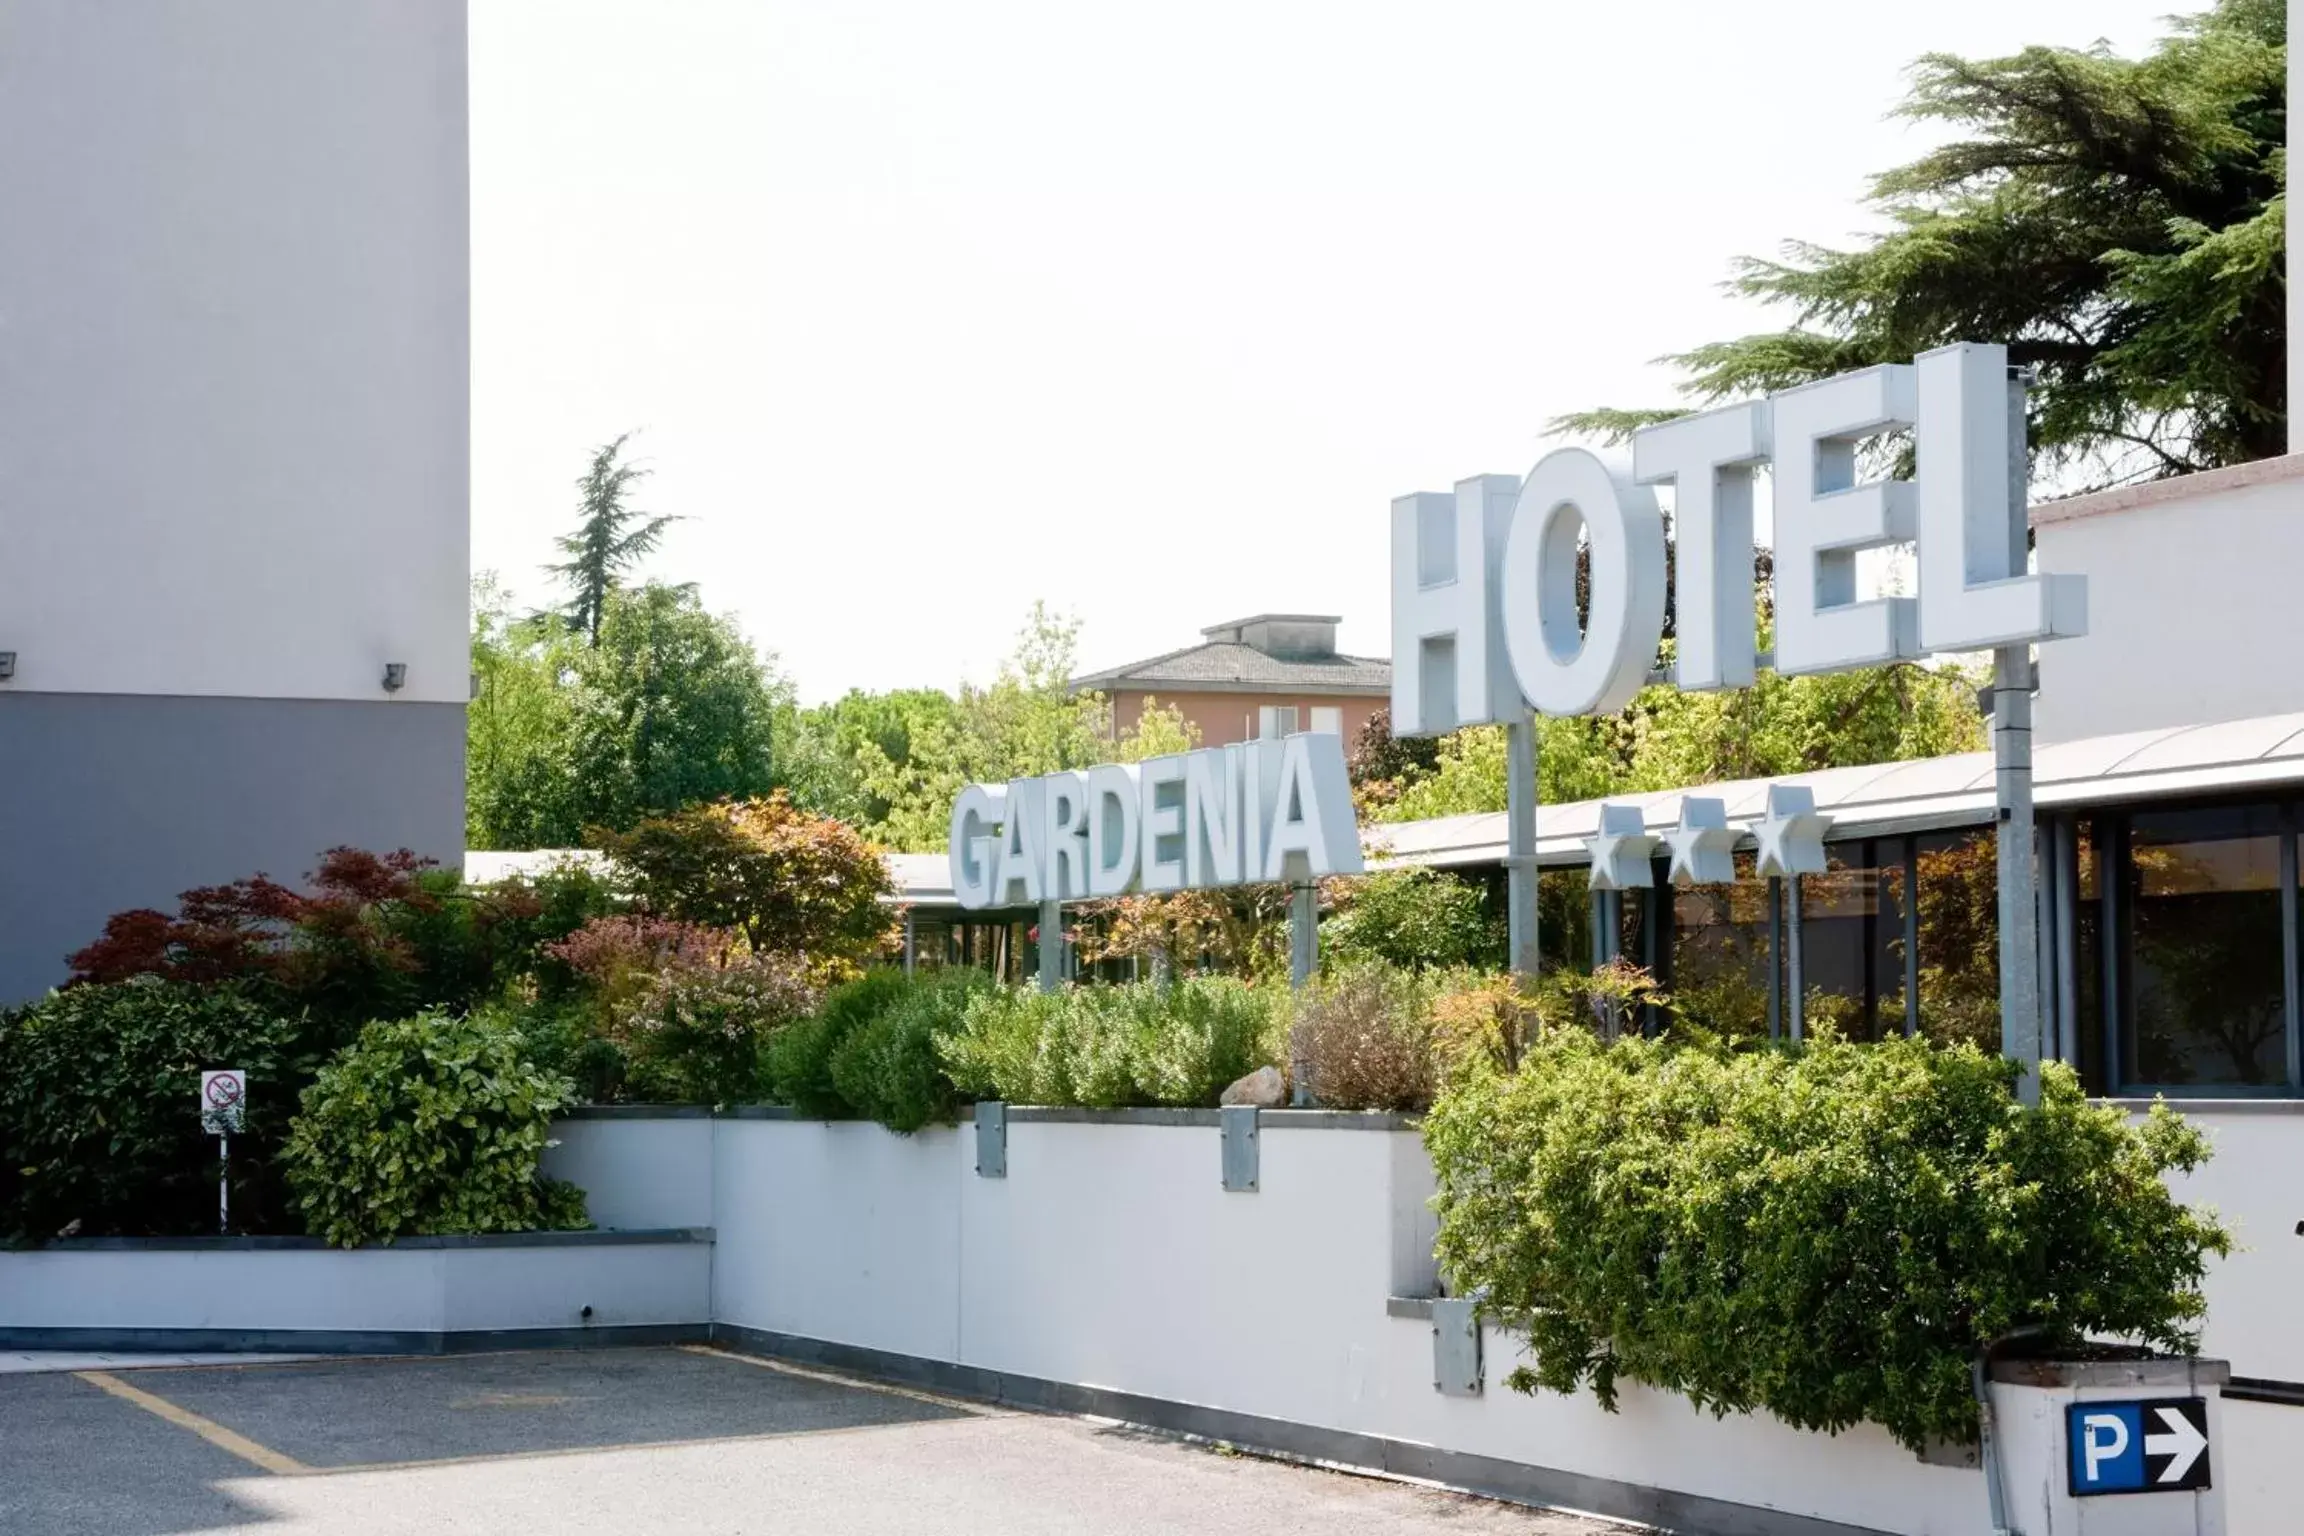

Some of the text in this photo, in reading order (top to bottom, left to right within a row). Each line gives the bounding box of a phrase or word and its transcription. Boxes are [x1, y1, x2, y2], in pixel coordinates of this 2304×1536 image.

[1391, 342, 2088, 737] HOTEL
[949, 732, 1363, 909] GARDENIA
[2083, 1414, 2129, 1482] P
